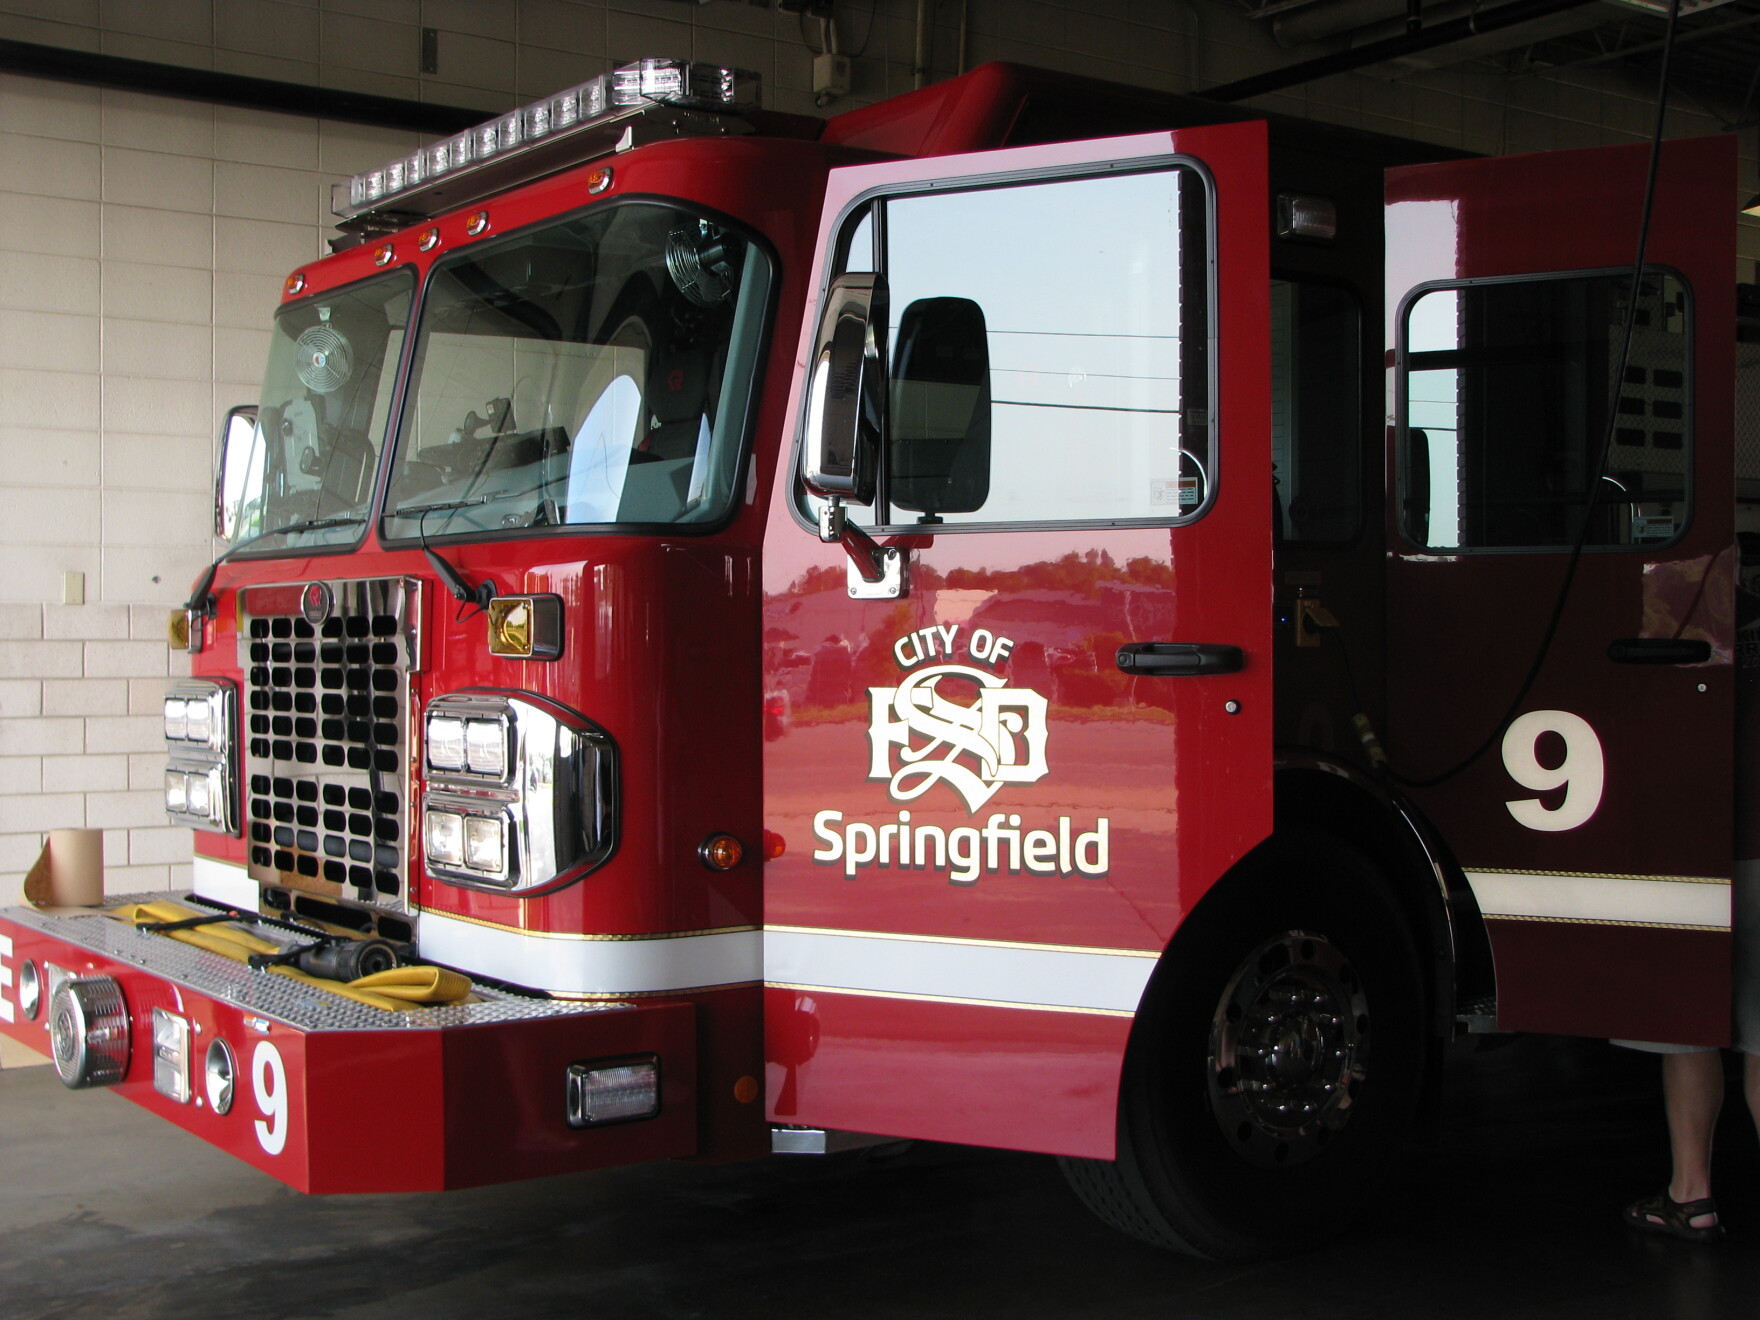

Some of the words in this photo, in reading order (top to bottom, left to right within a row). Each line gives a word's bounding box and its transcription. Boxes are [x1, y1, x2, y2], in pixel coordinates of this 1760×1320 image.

[893, 624, 959, 669] CITY
[968, 628, 1014, 664] OF
[1501, 709, 1605, 832] 9
[812, 809, 1110, 882] Springfield
[252, 1040, 288, 1156] 9
